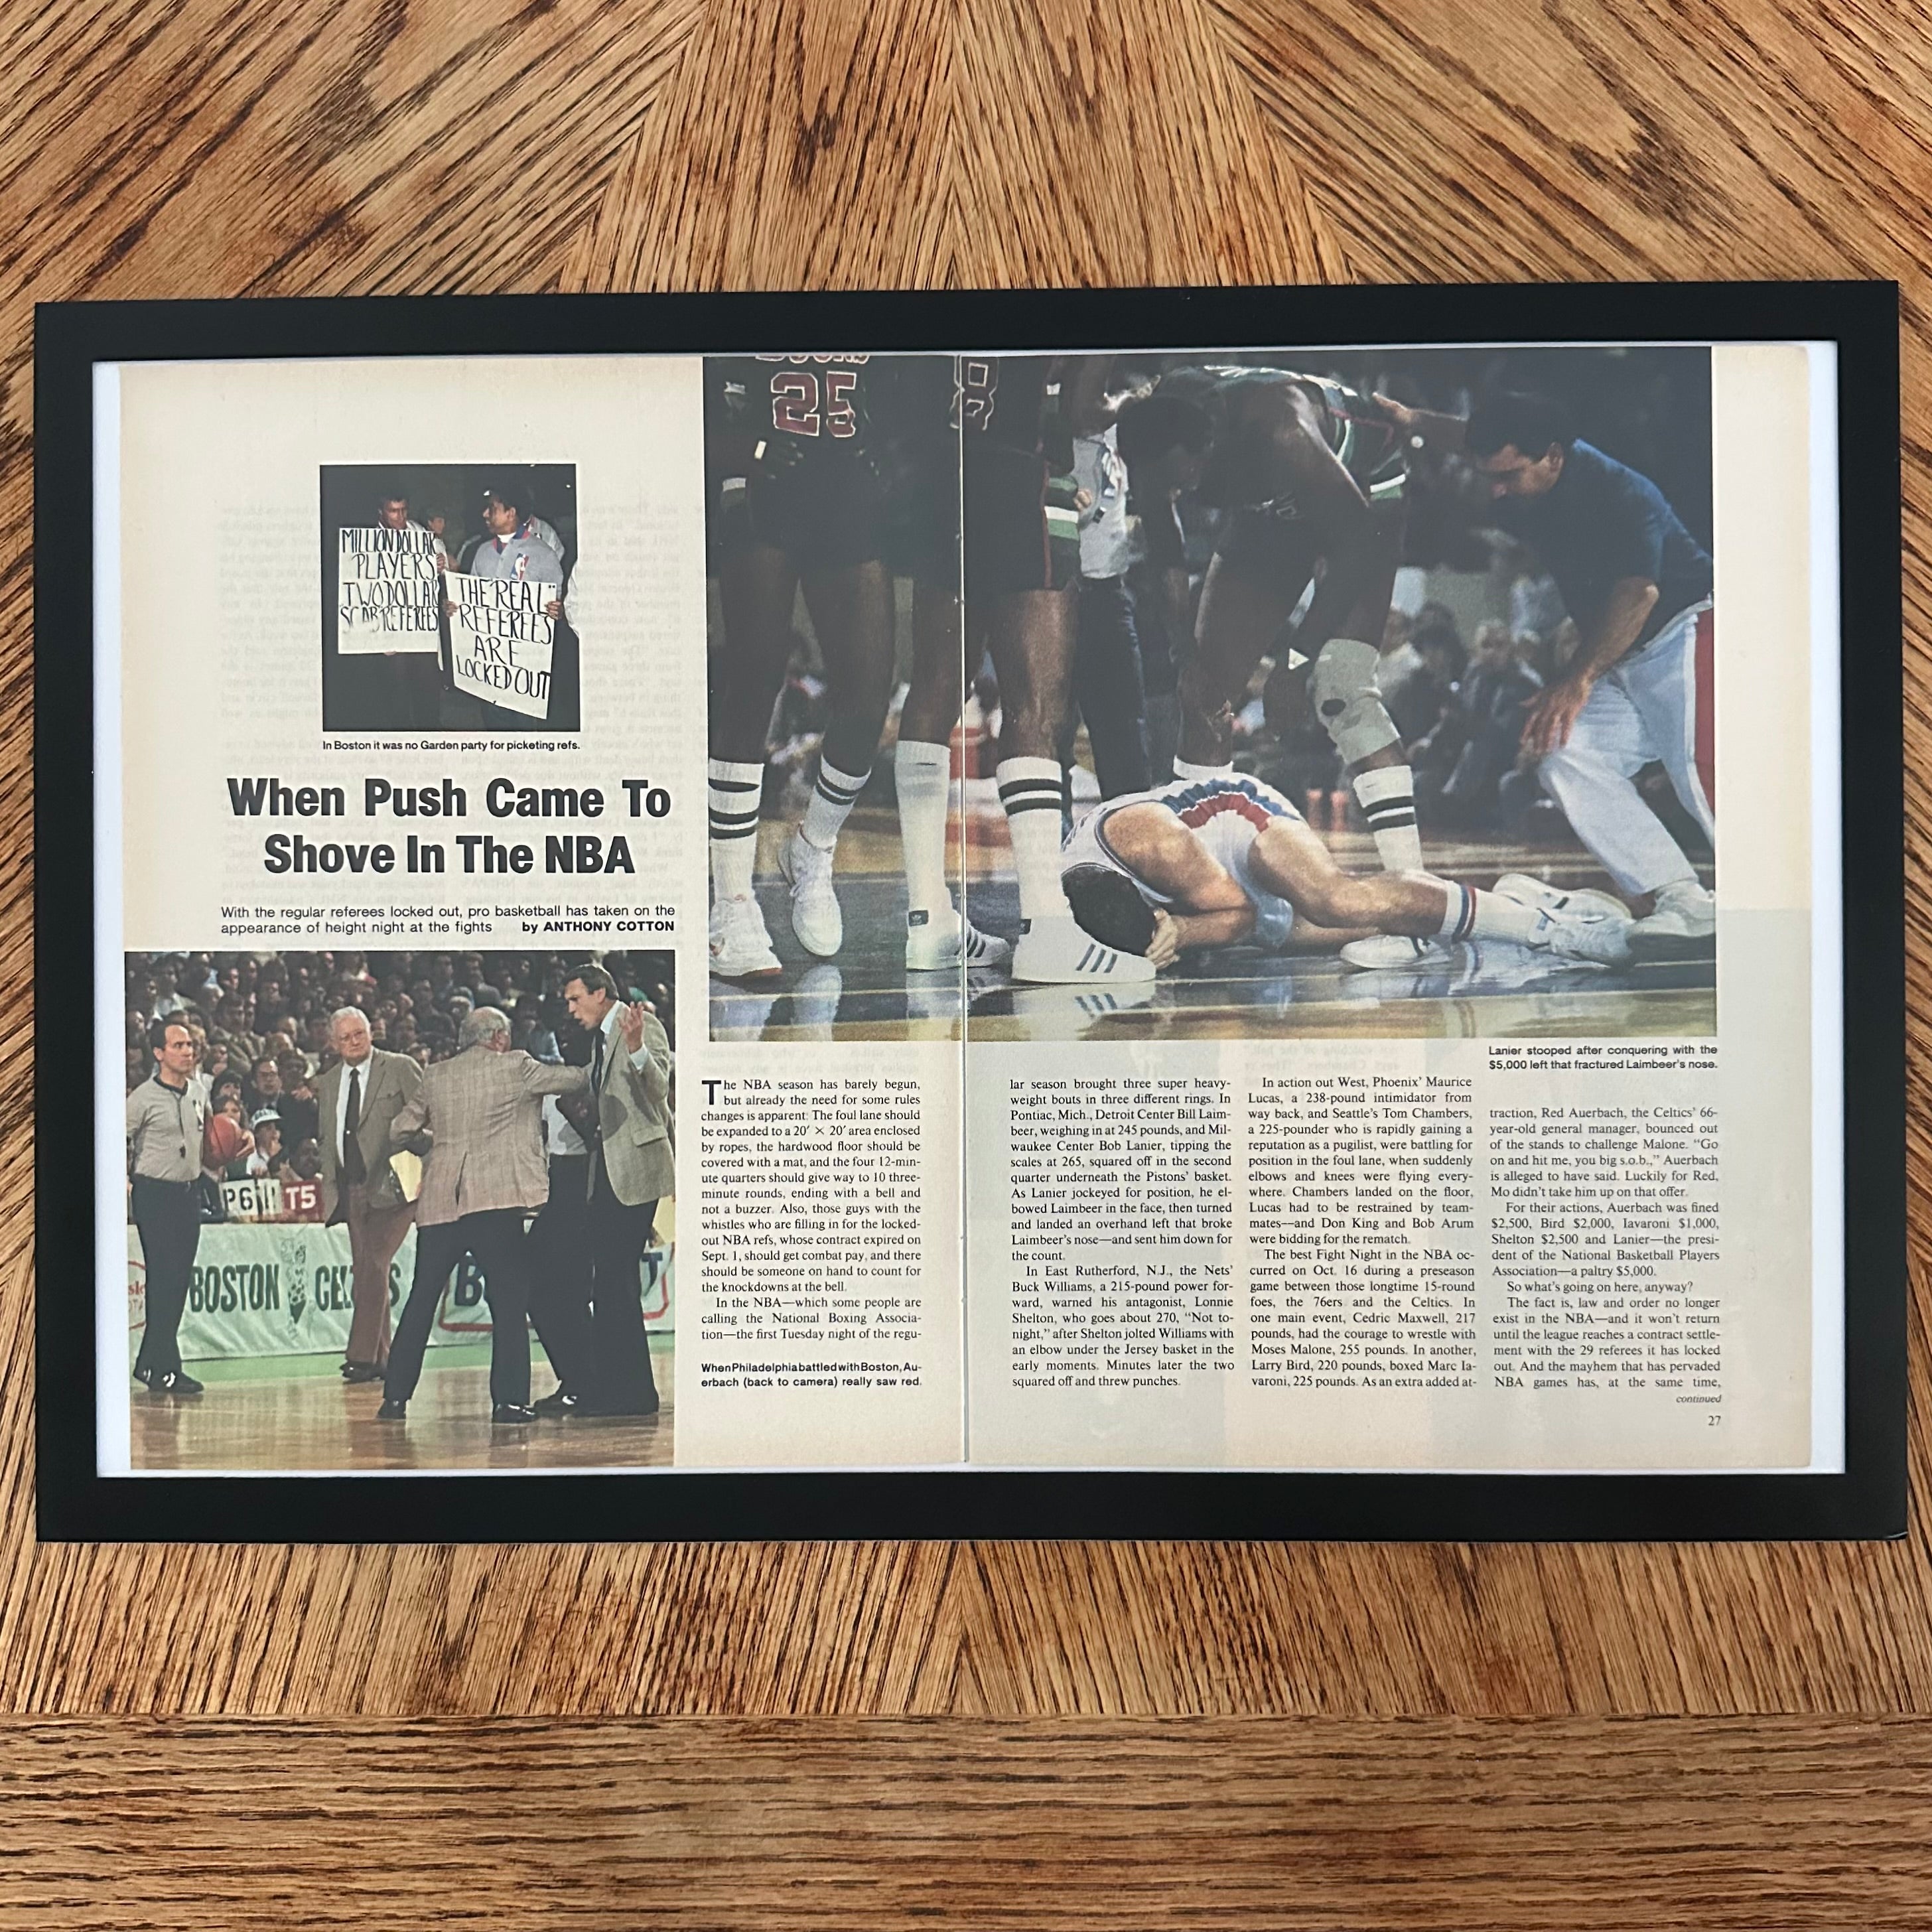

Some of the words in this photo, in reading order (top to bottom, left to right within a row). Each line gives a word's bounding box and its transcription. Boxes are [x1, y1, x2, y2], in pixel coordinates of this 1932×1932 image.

[770, 371, 857, 437] 25
[342, 529, 393, 553] MILLION
[396, 530, 437, 555] DOLLAR
[352, 553, 435, 580] PLAYERS
[343, 581, 383, 606] TWO
[456, 577, 490, 606] THE
[380, 605, 439, 631] REFEREES
[459, 604, 551, 644] REFEREES
[474, 635, 523, 670] ARE
[456, 655, 512, 690] LOCKED
[514, 668, 551, 700] OUT
[322, 740, 332, 750] In
[334, 740, 372, 750] Boston
[374, 740, 380, 750] it
[420, 740, 459, 750] Garden
[461, 741, 488, 752] party
[490, 740, 505, 750] for
[507, 740, 555, 752] picketing
[557, 740, 581, 750] refs.
[226, 778, 345, 817] When
[365, 778, 466, 817] Push
[486, 778, 604, 818] Came
[622, 779, 671, 817] To
[264, 833, 395, 874] Shove
[407, 835, 445, 873] In
[455, 835, 534, 874] The
[545, 835, 636, 874] NBA
[221, 906, 249, 918] With
[255, 906, 275, 918] the
[281, 906, 326, 920] regular
[330, 906, 385, 918] referees
[390, 906, 433, 918] locked
[439, 906, 462, 918] out,
[468, 908, 490, 920] pro
[495, 905, 561, 917] basketball
[566, 905, 588, 916] has
[593, 905, 629, 916] taken
[634, 907, 650, 916] on
[655, 904, 675, 916] the
[221, 924, 301, 936] appearance
[307, 922, 320, 933] of
[325, 921, 366, 935] height
[372, 921, 405, 935] night
[409, 922, 423, 933] at
[428, 921, 450, 933] the
[454, 921, 492, 935] fights
[522, 921, 538, 934] by
[543, 921, 612, 932] ANTHONY
[616, 921, 674, 932] COTTON
[1489, 1046, 1522, 1056] Lanier
[1527, 1046, 1572, 1057] stooped
[1576, 1046, 1603, 1055] after
[1607, 1046, 1668, 1057] conquering
[1673, 1045, 1695, 1054] with
[1700, 1045, 1718, 1054] the
[1489, 1060, 1527, 1071] $5,000
[1530, 1060, 1548, 1070] left
[1551, 1060, 1572, 1069] that
[1574, 1060, 1624, 1070] fractured
[1626, 1059, 1686, 1069] Laimbeer's
[743, 1079, 772, 1090] NBA
[778, 1081, 813, 1090] season
[820, 1079, 838, 1089] has
[845, 1079, 878, 1091] barely
[884, 1079, 920, 1091] begun,
[1489, 1123, 1536, 1136] year-old
[1541, 1123, 1582, 1136] general
[1588, 1125, 1639, 1136] manager,
[1645, 1123, 1694, 1133] bounced
[1699, 1125, 1718, 1133] out
[1010, 1156, 1042, 1168] scales
[1046, 1158, 1057, 1167] at
[1062, 1156, 1085, 1168] 265,
[1089, 1156, 1133, 1168] squared
[1137, 1155, 1152, 1166] off
[1156, 1156, 1167, 1166] in
[1172, 1156, 1189, 1166] the
[1194, 1155, 1231, 1166] second
[285, 1185, 316, 1210] T5
[1249, 1186, 1286, 1197] where.
[1292, 1186, 1349, 1197] Chambers
[1355, 1186, 1393, 1197] landed
[1419, 1186, 1438, 1197] the
[1444, 1186, 1474, 1198] floor,
[701, 1237, 719, 1246] out
[723, 1234, 751, 1246] NBA
[754, 1234, 777, 1247] refs,
[779, 1234, 813, 1245] whose
[816, 1235, 861, 1245] contract
[863, 1234, 904, 1247] expired
[1491, 1249, 1517, 1260] dent
[1521, 1249, 1534, 1261] of
[1539, 1249, 1556, 1260] the
[1561, 1249, 1611, 1261] National
[1616, 1249, 1673, 1261] Basketball
[1679, 1249, 1720, 1263] Players
[190, 1263, 280, 1313] BOSTON
[1012, 1297, 1043, 1310] ward,
[1052, 1296, 1092, 1308] warned
[1101, 1296, 1117, 1307] his
[1126, 1296, 1186, 1310] antagonist,
[1194, 1296, 1233, 1307] Lonnie
[1250, 1296, 1276, 1308] foes,
[1286, 1296, 1303, 1307] the
[1313, 1296, 1343, 1307] 76ers
[1352, 1296, 1373, 1307] and
[1383, 1296, 1401, 1308] the
[1411, 1296, 1453, 1308] Celtics.
[1464, 1296, 1476, 1308] In
[701, 1313, 738, 1326] calling
[746, 1313, 763, 1324] the
[772, 1312, 819, 1324] National
[829, 1312, 867, 1325] Boxing
[875, 1312, 922, 1323] Associa-
[1251, 1344, 1286, 1355] Moses
[1290, 1344, 1336, 1356] Malone,
[1340, 1344, 1359, 1355] 255
[1365, 1344, 1408, 1357] pounds.
[1413, 1344, 1425, 1355] In
[1430, 1344, 1476, 1357] another,
[701, 1363, 731, 1373] When
[732, 1362, 798, 1374] Philadelphia
[799, 1362, 837, 1372] battled
[838, 1362, 860, 1371] with
[861, 1362, 902, 1373] Boston,
[903, 1362, 922, 1371] Au-
[701, 1377, 739, 1387] erbach
[743, 1377, 774, 1389] (back
[778, 1377, 789, 1387] to
[793, 1376, 838, 1389] camera)
[842, 1376, 872, 1388] really
[901, 1377, 922, 1386] red.
[1012, 1375, 1056, 1389] squared
[1058, 1375, 1074, 1387] off
[1075, 1375, 1095, 1386] and
[1098, 1375, 1130, 1386] threw
[1133, 1375, 1181, 1389] punches.
[1676, 1395, 1722, 1403] continued
[1708, 1415, 1721, 1426] 27
